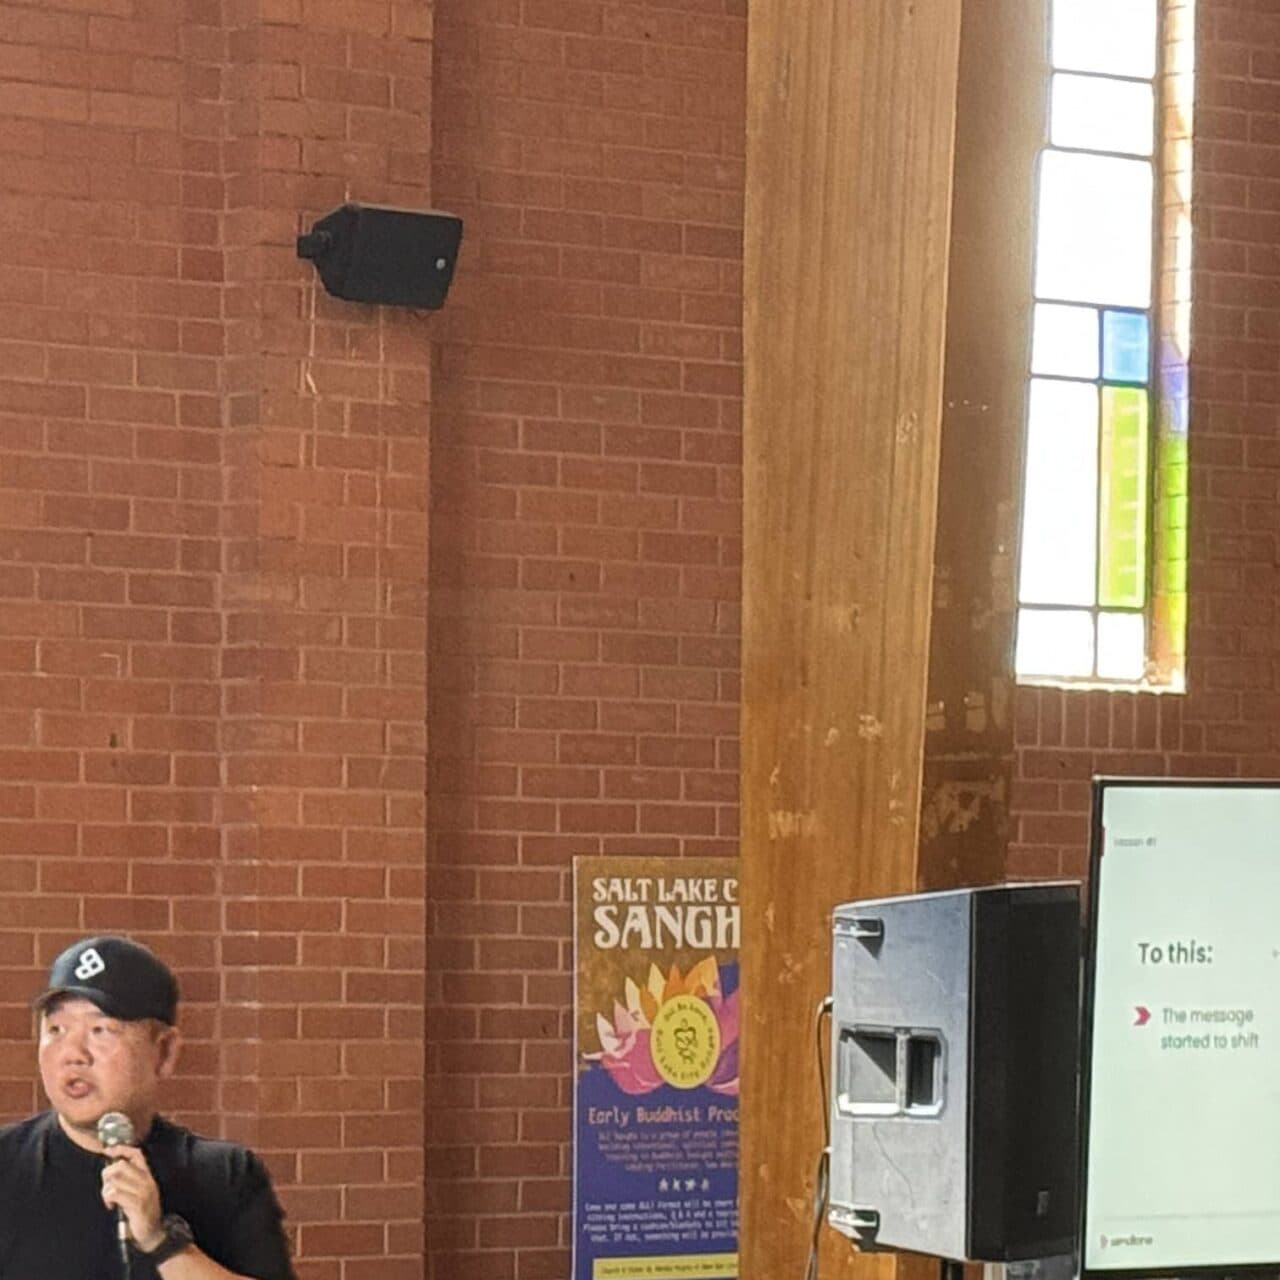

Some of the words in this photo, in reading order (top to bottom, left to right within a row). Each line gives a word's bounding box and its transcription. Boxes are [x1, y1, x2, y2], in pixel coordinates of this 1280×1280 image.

[592, 877, 653, 902] SALT
[658, 878, 718, 902] LAKE
[593, 905, 740, 949] SANGH
[1138, 942, 1163, 964] To
[1168, 939, 1213, 964] this:
[1163, 1008, 1187, 1024] The
[1190, 1009, 1254, 1027] message
[1161, 1034, 1210, 1049] started
[1214, 1035, 1228, 1048] to
[1231, 1032, 1259, 1048] shift
[588, 1106, 629, 1127] Early
[636, 1106, 700, 1122] Buddhist
